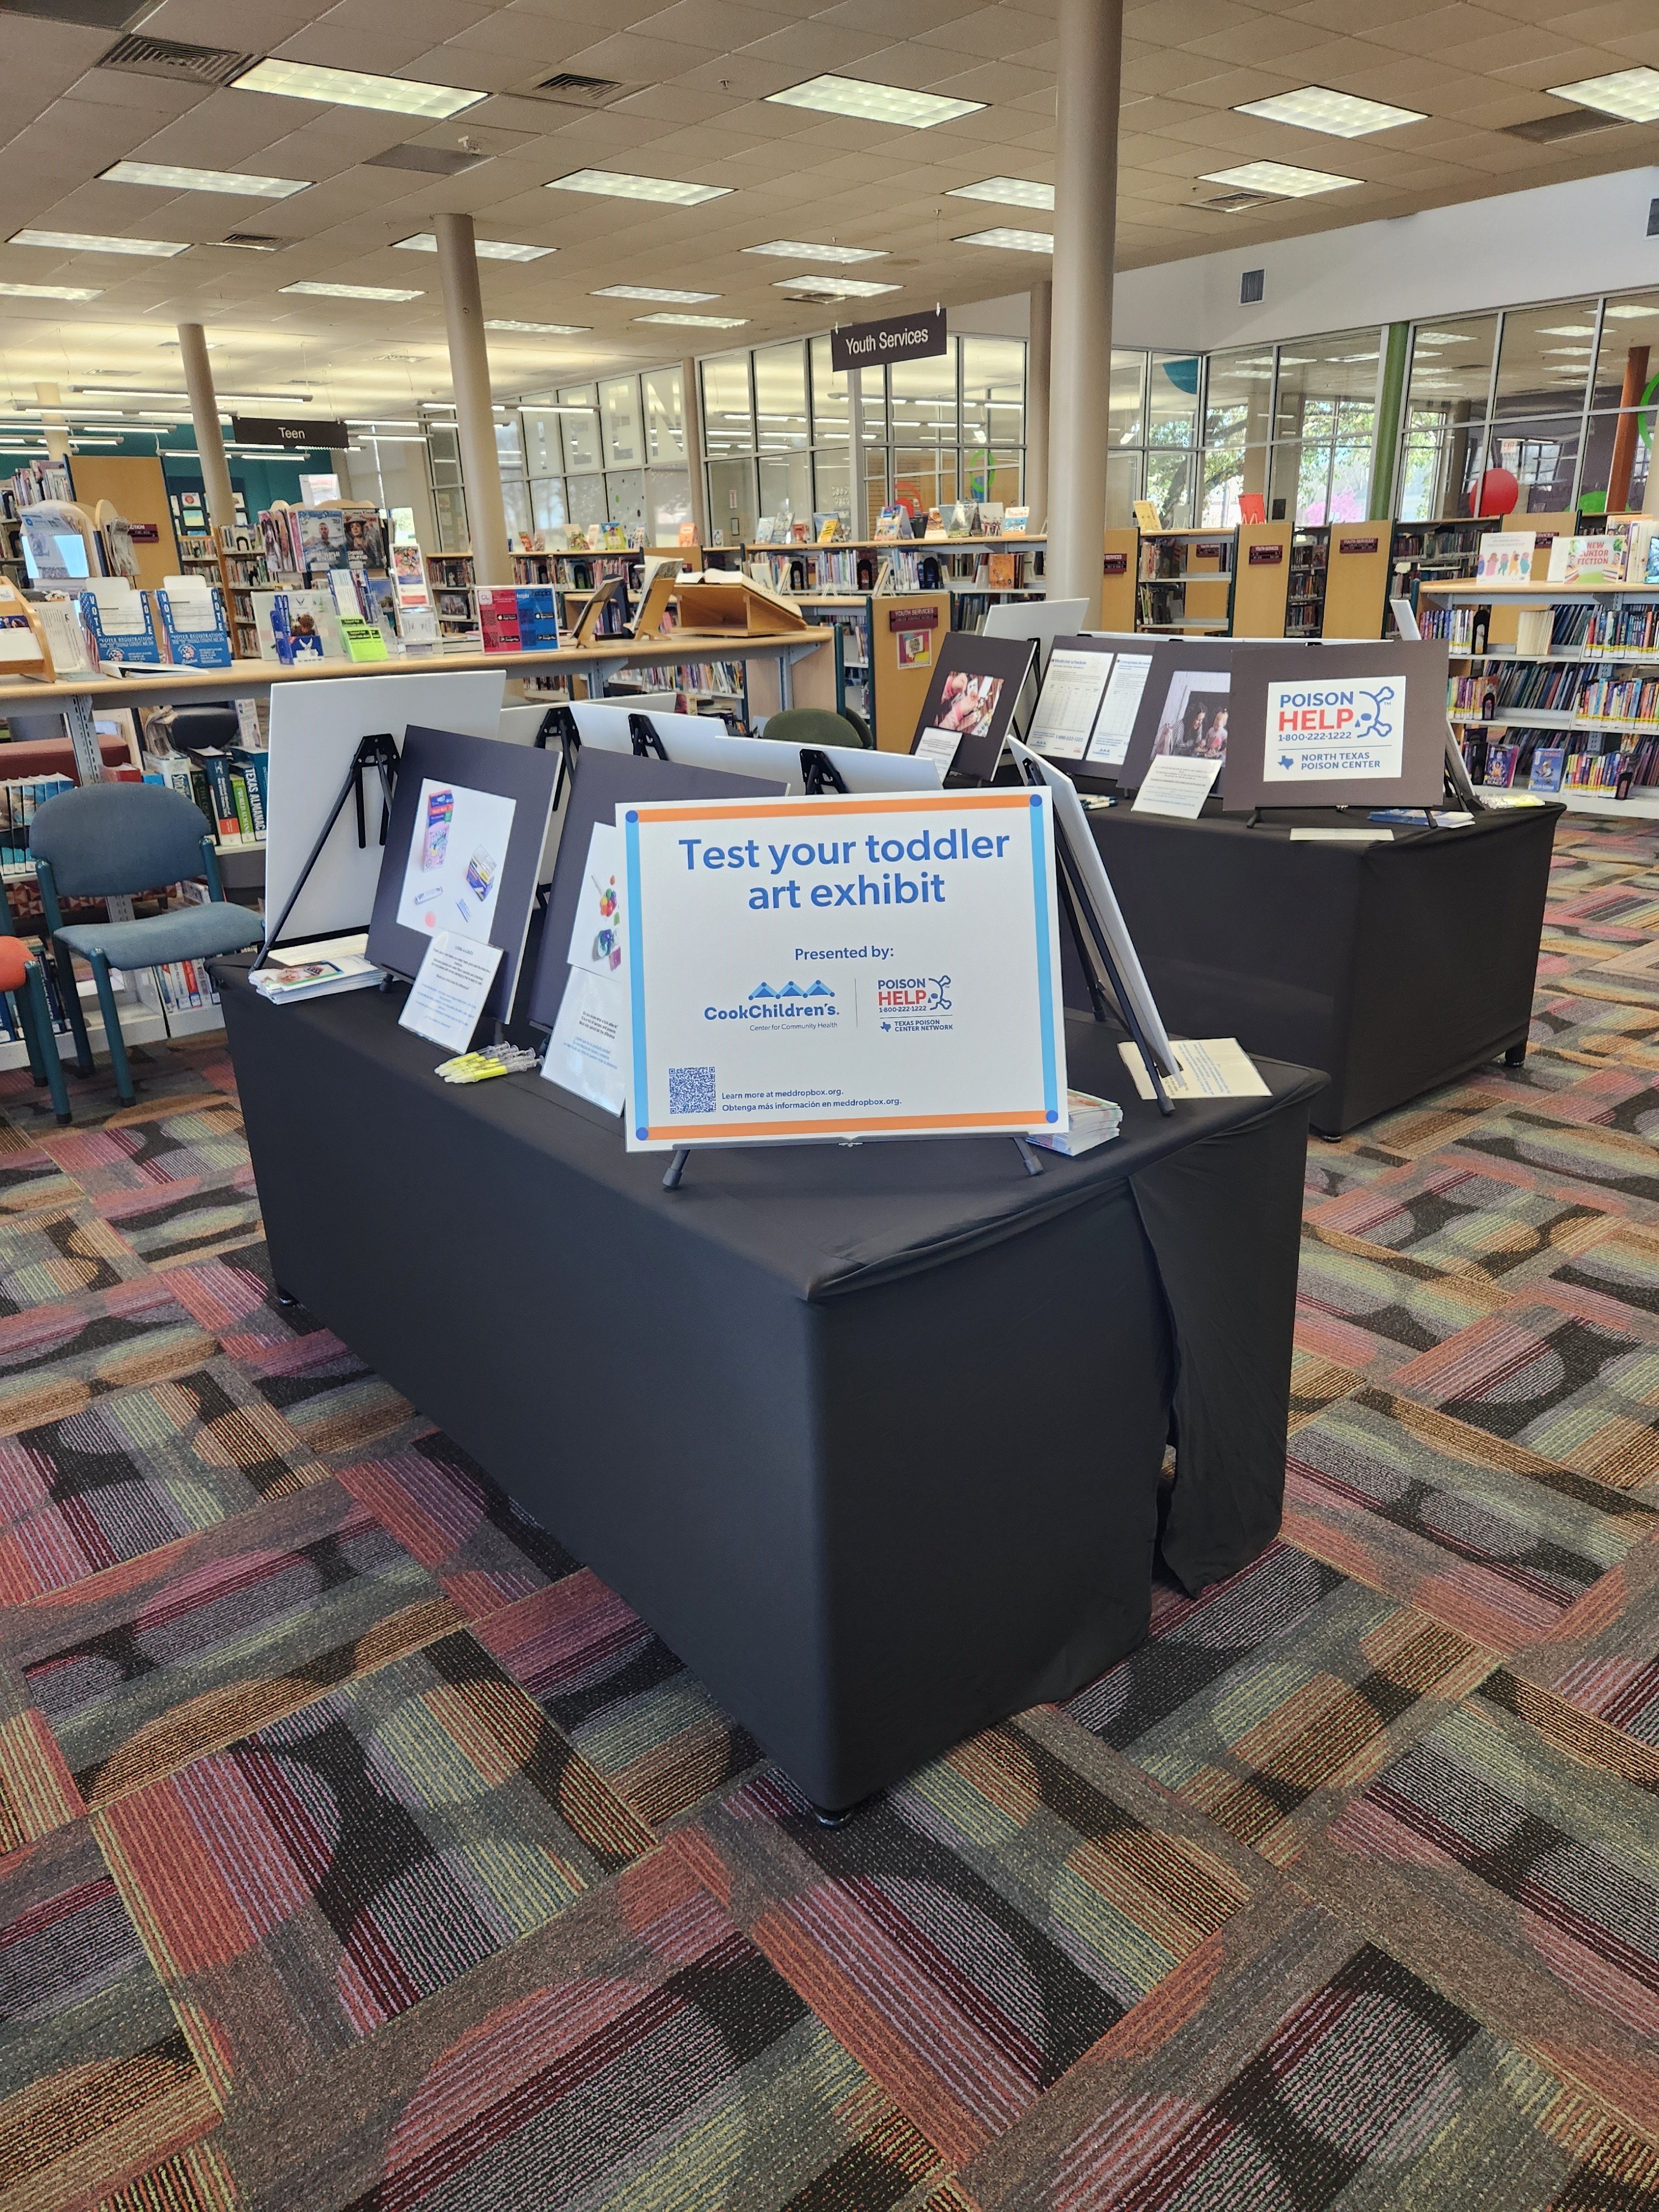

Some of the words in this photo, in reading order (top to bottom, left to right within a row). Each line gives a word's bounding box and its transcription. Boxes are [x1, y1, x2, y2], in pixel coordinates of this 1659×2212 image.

[845, 333, 877, 356] Youth
[878, 326, 929, 350] Services
[278, 426, 306, 440] Teen
[89, 595, 102, 637] VOTE
[140, 594, 153, 635] VOTE
[161, 593, 174, 634] VOTE
[212, 591, 224, 632] VOTE
[1280, 691, 1354, 708] POISON
[1278, 708, 1354, 732] HELP
[1342, 760, 1381, 769] CENTER
[244, 767, 259, 794] TEXAS
[249, 793, 265, 831] ALMANAC
[679, 838, 760, 870] Test
[768, 839, 857, 875] your
[865, 828, 1010, 863] toddler
[748, 880, 801, 910] art
[811, 872, 946, 908] exhibit
[795, 946, 868, 961] Presented
[872, 945, 895, 961] by:
[878, 978, 926, 990] POISON
[878, 990, 927, 1006] HELP
[781, 1022, 816, 1031] Community
[722, 1103, 757, 1113] Obtenga
[758, 1102, 774, 1110] más
[775, 1099, 821, 1109] información
[833, 1097, 902, 1108] meddropbox.org.
[775, 1088, 844, 1098] meddropbox.org.
